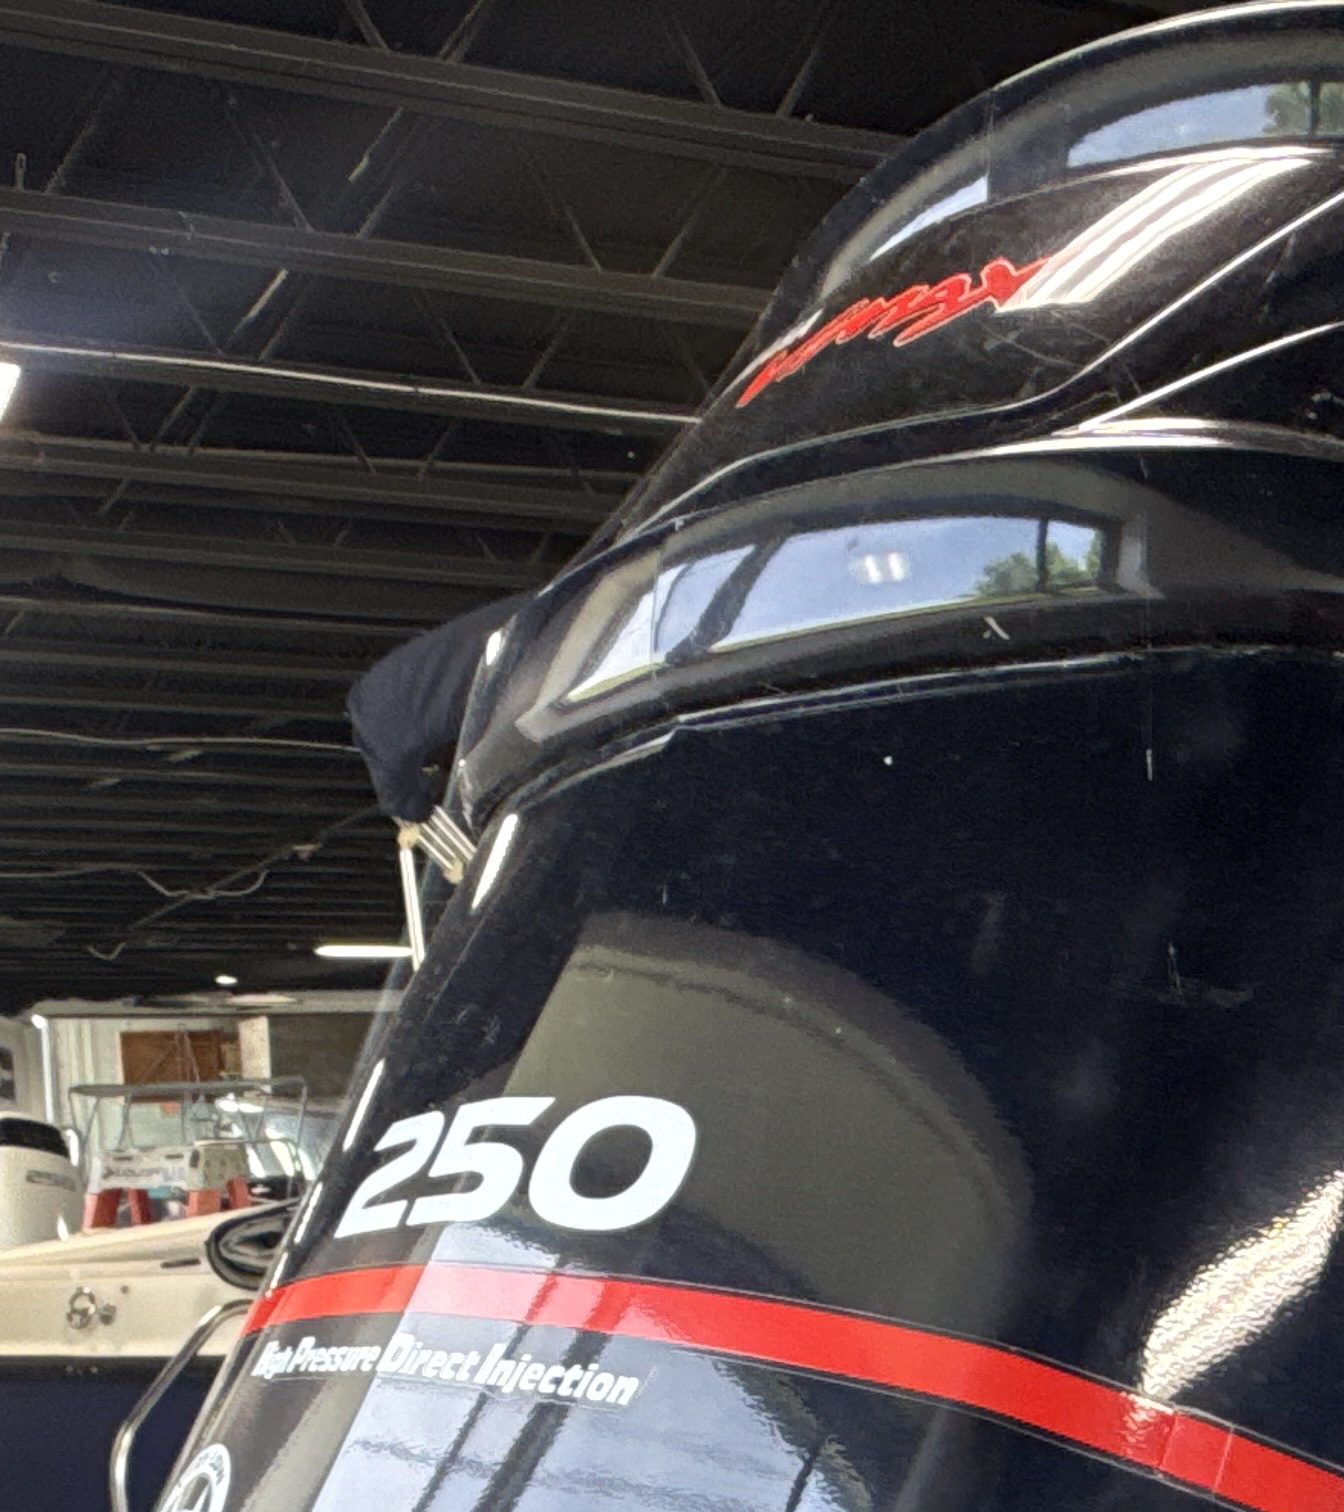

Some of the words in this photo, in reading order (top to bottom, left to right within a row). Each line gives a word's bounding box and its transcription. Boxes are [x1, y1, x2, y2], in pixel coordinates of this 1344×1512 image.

[334, 1095, 697, 1239] 250
[289, 1336, 382, 1373] Pressure
[376, 1332, 479, 1380] Direct
[473, 1342, 640, 1405] Injection
